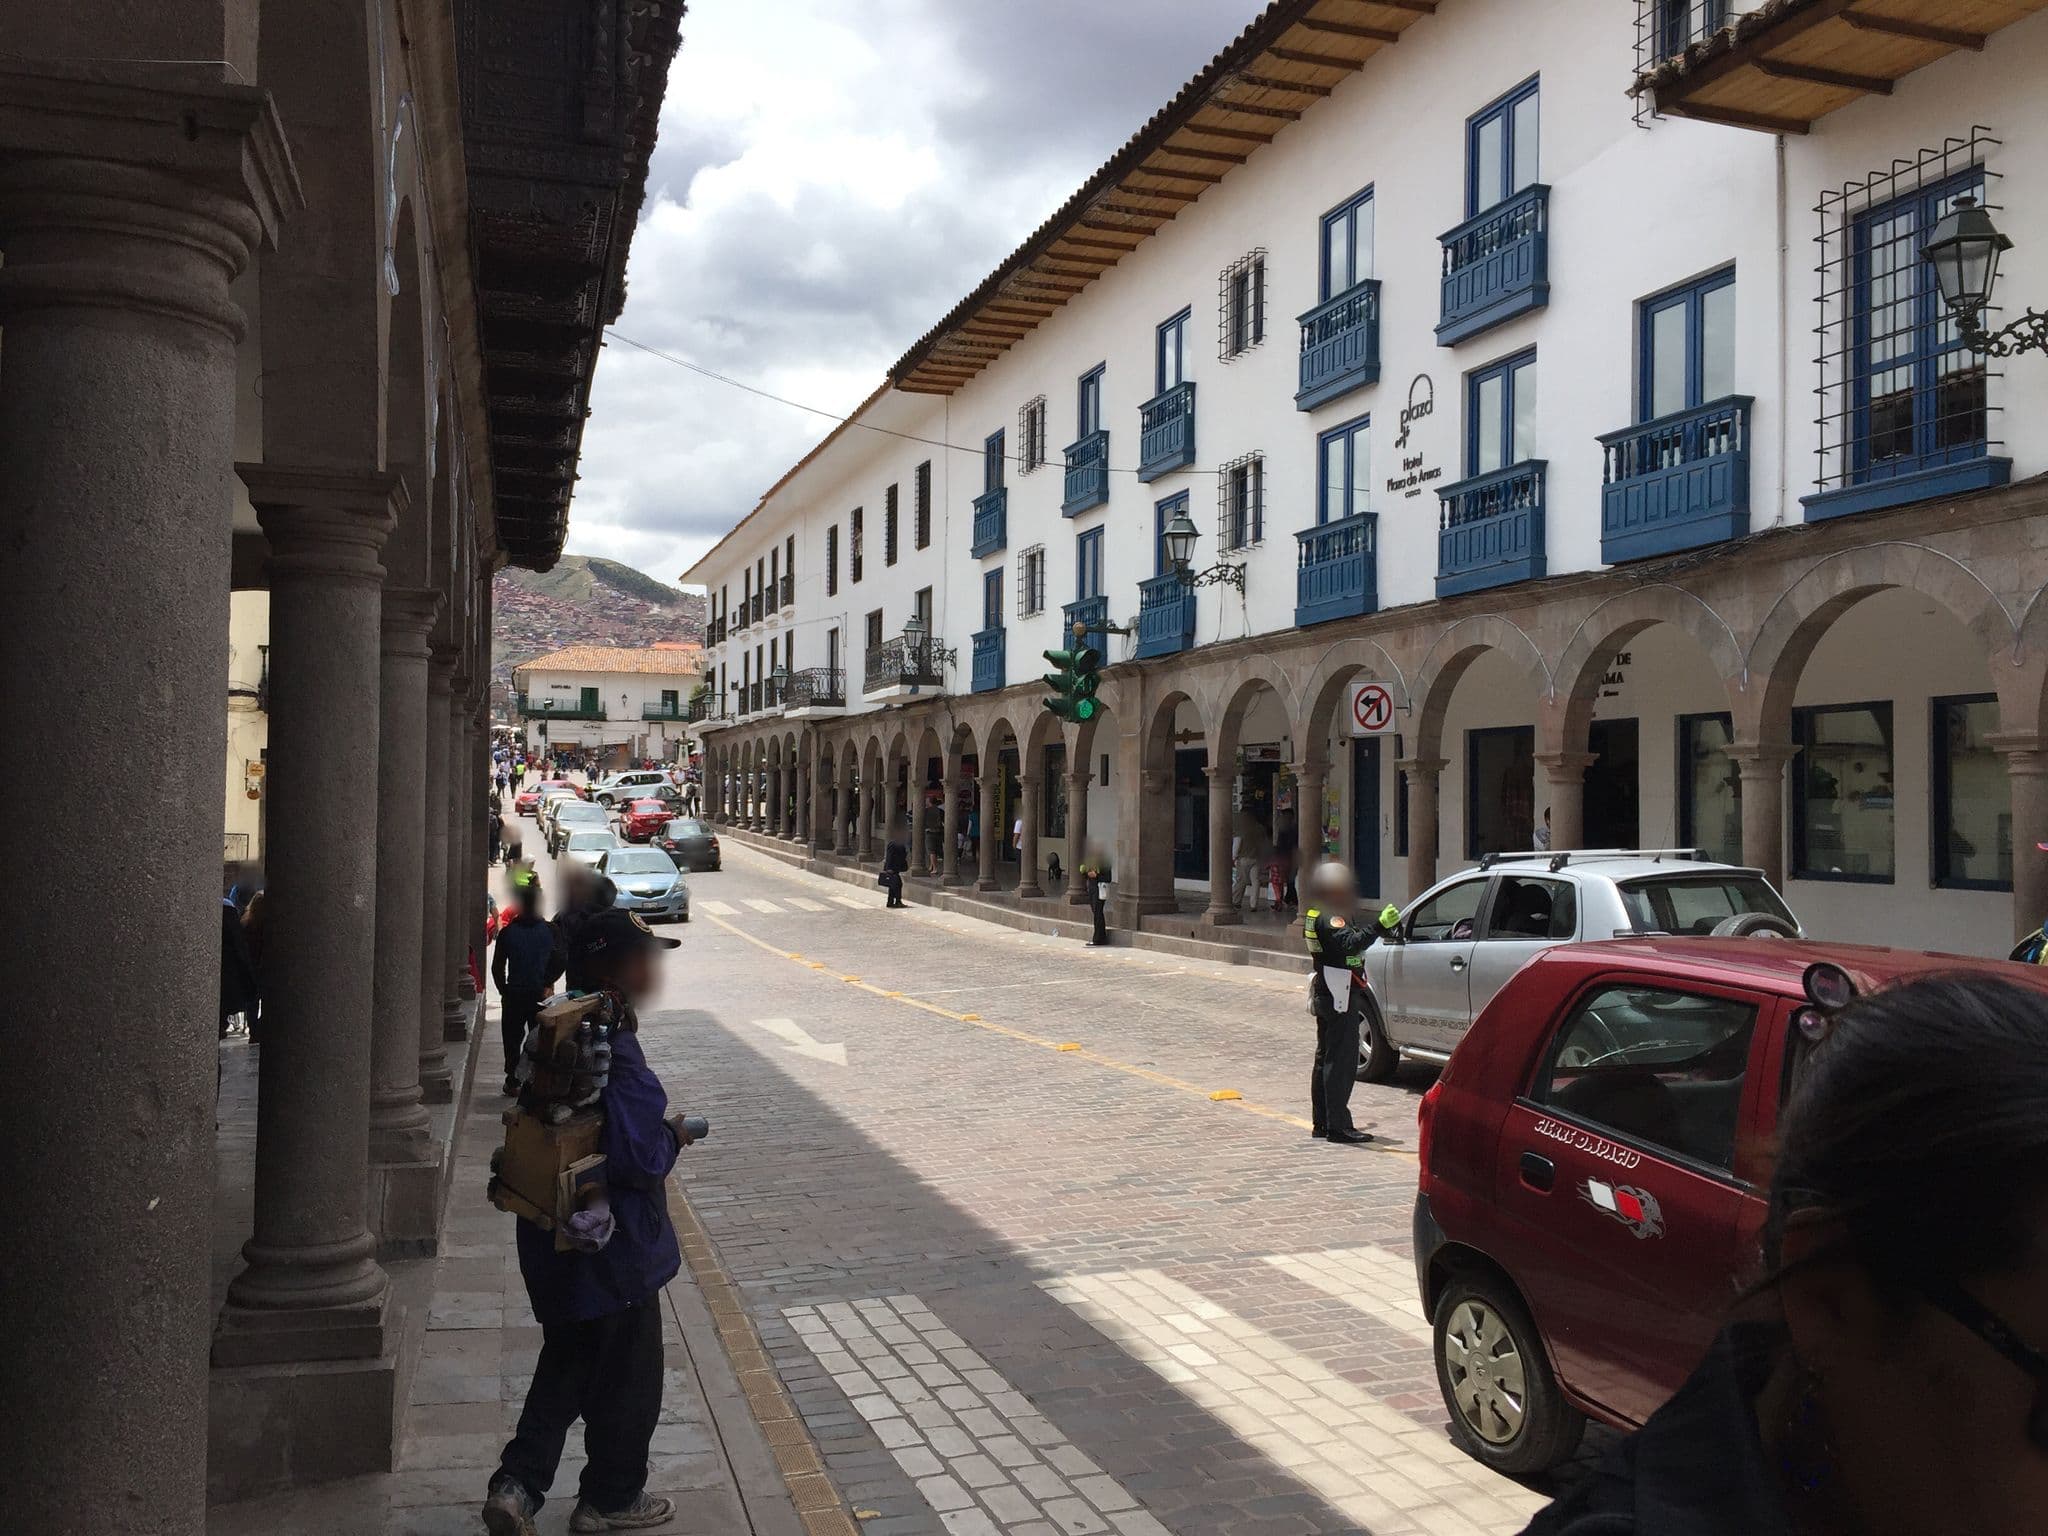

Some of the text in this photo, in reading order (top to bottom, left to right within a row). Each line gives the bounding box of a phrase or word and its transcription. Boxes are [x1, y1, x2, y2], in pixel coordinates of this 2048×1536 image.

[1400, 399, 1433, 433] plaza
[1403, 452, 1423, 471] Hotel
[1387, 468, 1441, 492] Plaza de Armas
[1616, 652, 1631, 665] DE
[1534, 1119, 1576, 1144] CIERRE
